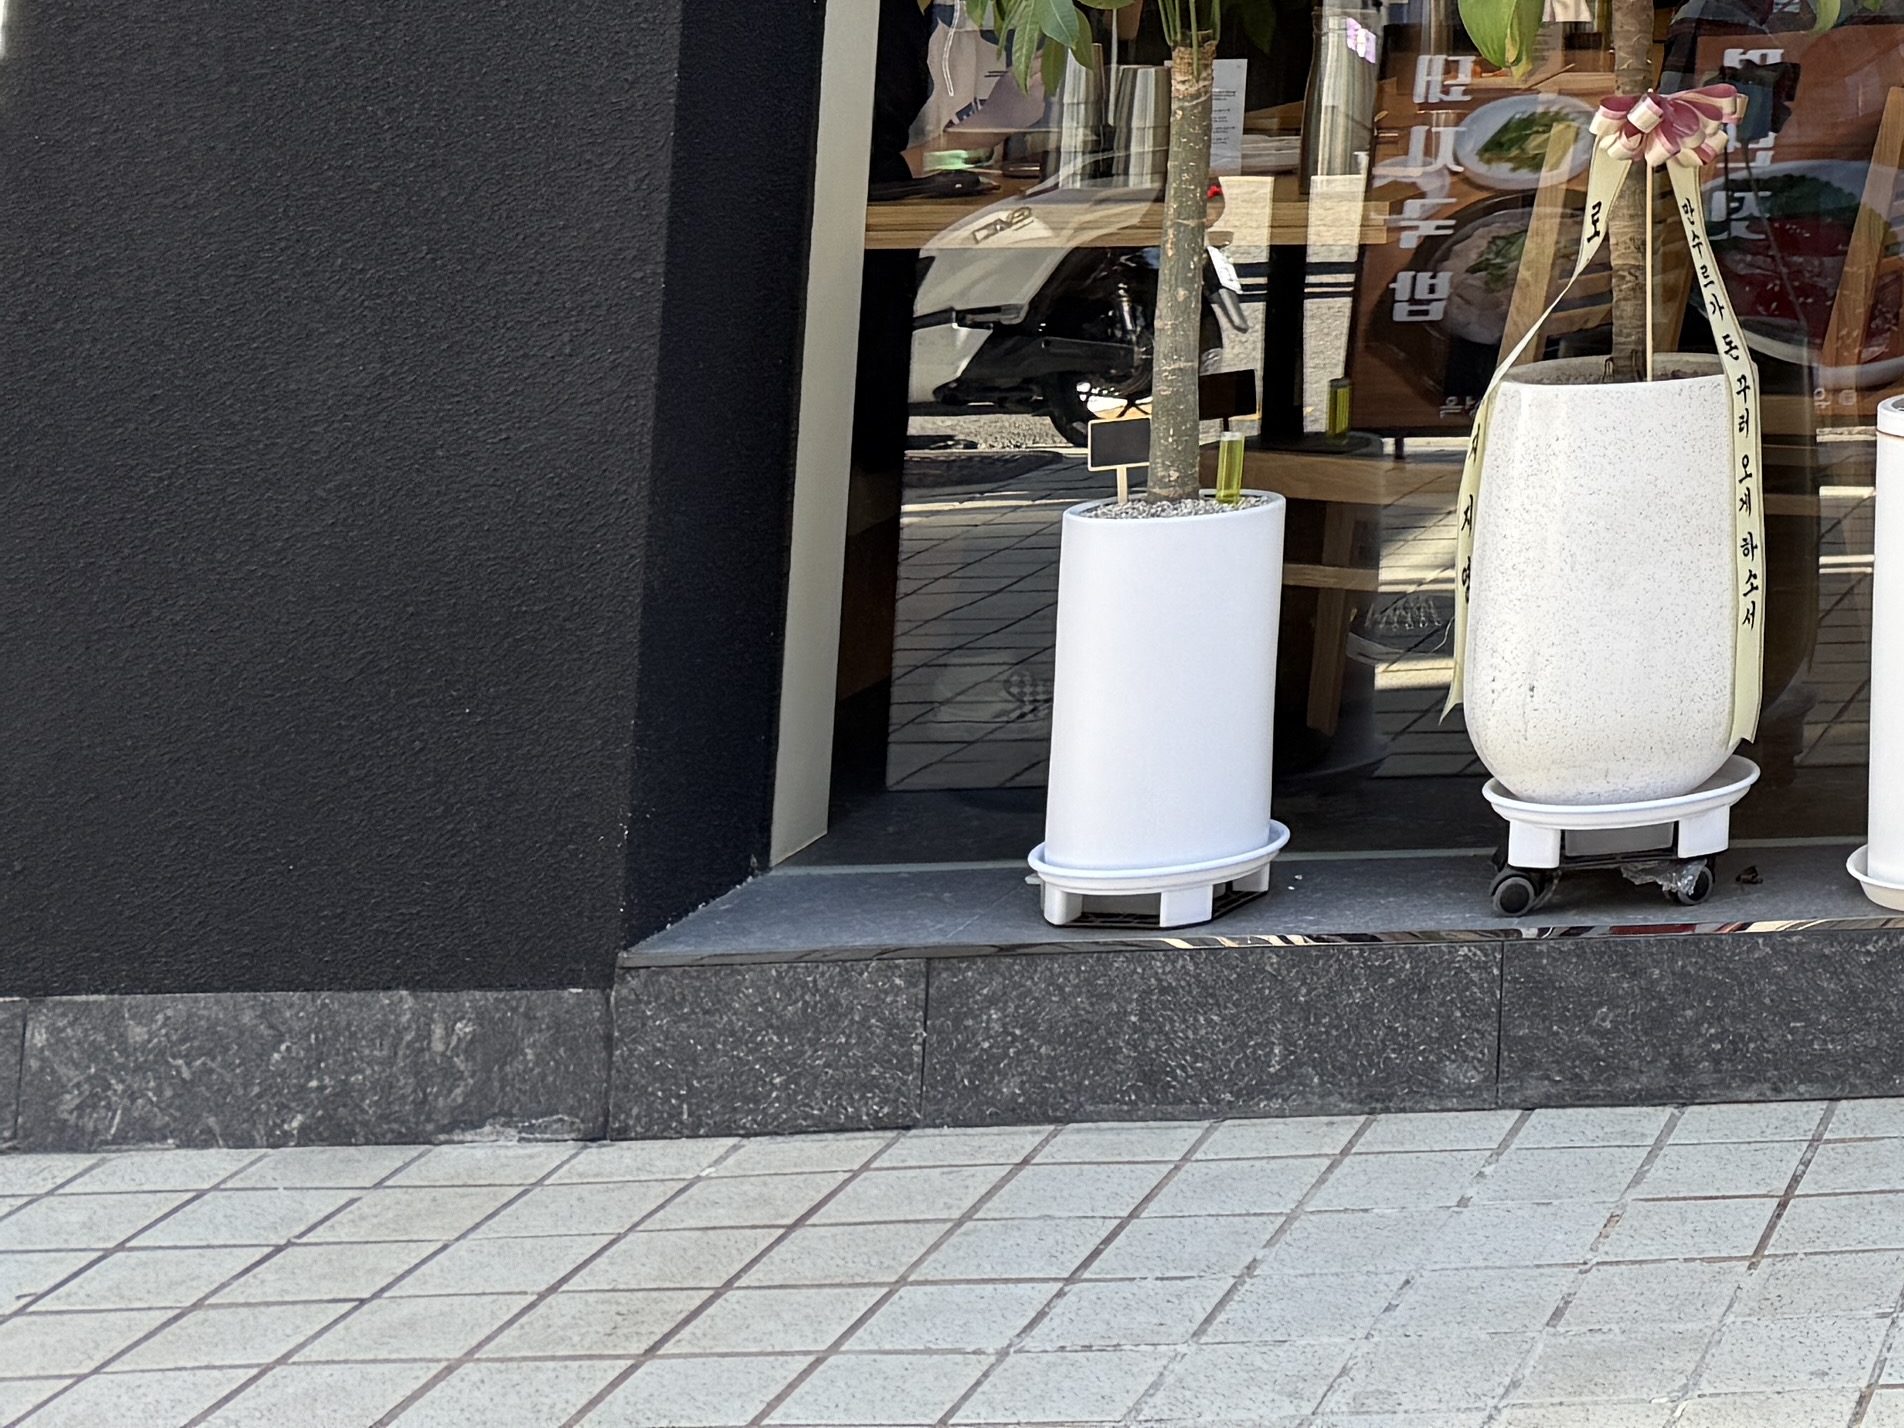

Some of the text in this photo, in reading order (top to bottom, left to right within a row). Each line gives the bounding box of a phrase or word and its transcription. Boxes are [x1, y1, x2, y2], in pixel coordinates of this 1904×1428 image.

[1682, 197, 1725, 321] 만수르가
[1722, 334, 1740, 361] 돈
[1740, 531, 1759, 632] 하소서
